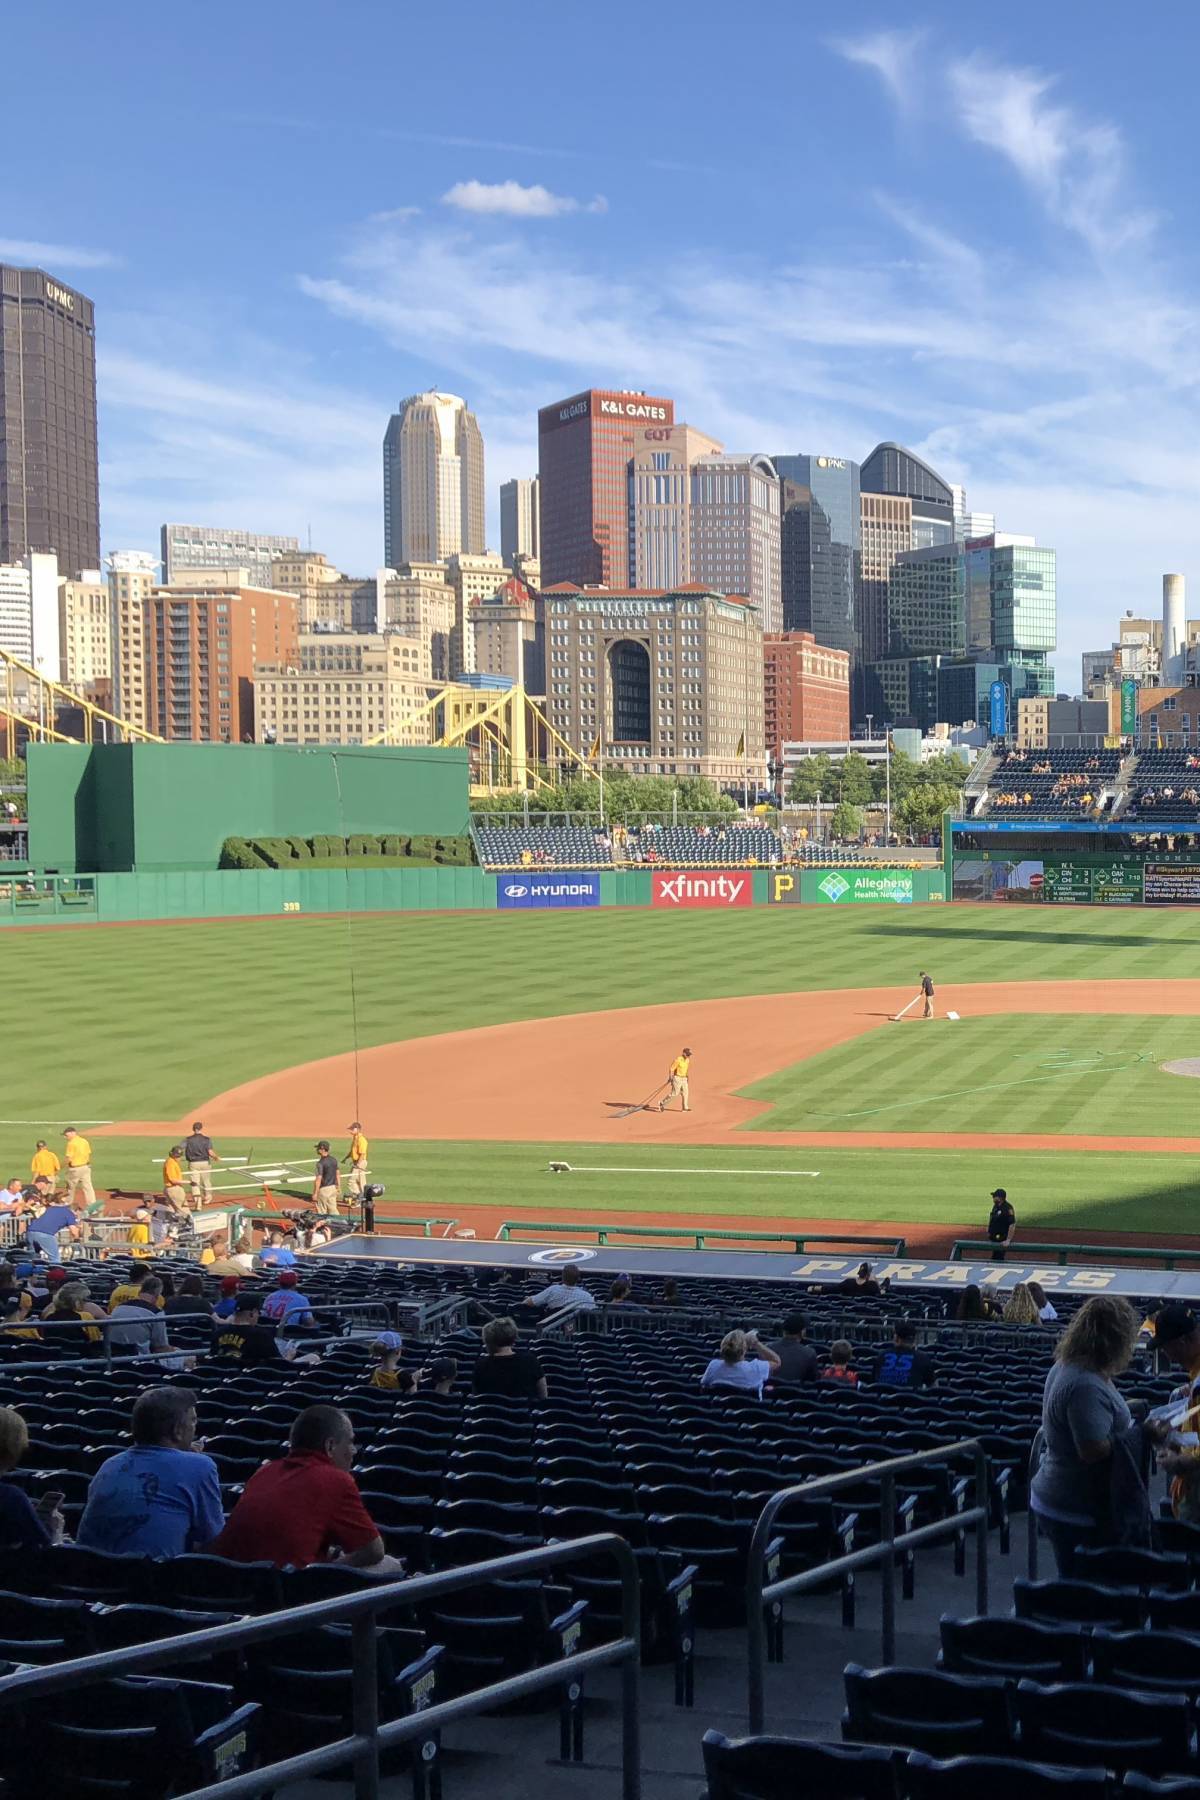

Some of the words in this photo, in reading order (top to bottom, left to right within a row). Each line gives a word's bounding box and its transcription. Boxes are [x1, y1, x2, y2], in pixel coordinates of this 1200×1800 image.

[47, 282, 74, 310] UPMC
[559, 407, 570, 420] K&L
[569, 400, 587, 416] GATES
[601, 400, 624, 415] K&L
[626, 403, 666, 420] GATES
[644, 428, 672, 441] EQT
[827, 459, 846, 469] PNC
[1124, 696, 1132, 713] AHN
[531, 885, 593, 896] HYUNDAI
[659, 875, 745, 903] xfinity
[774, 874, 794, 901] P
[854, 878, 912, 890] Allegheny
